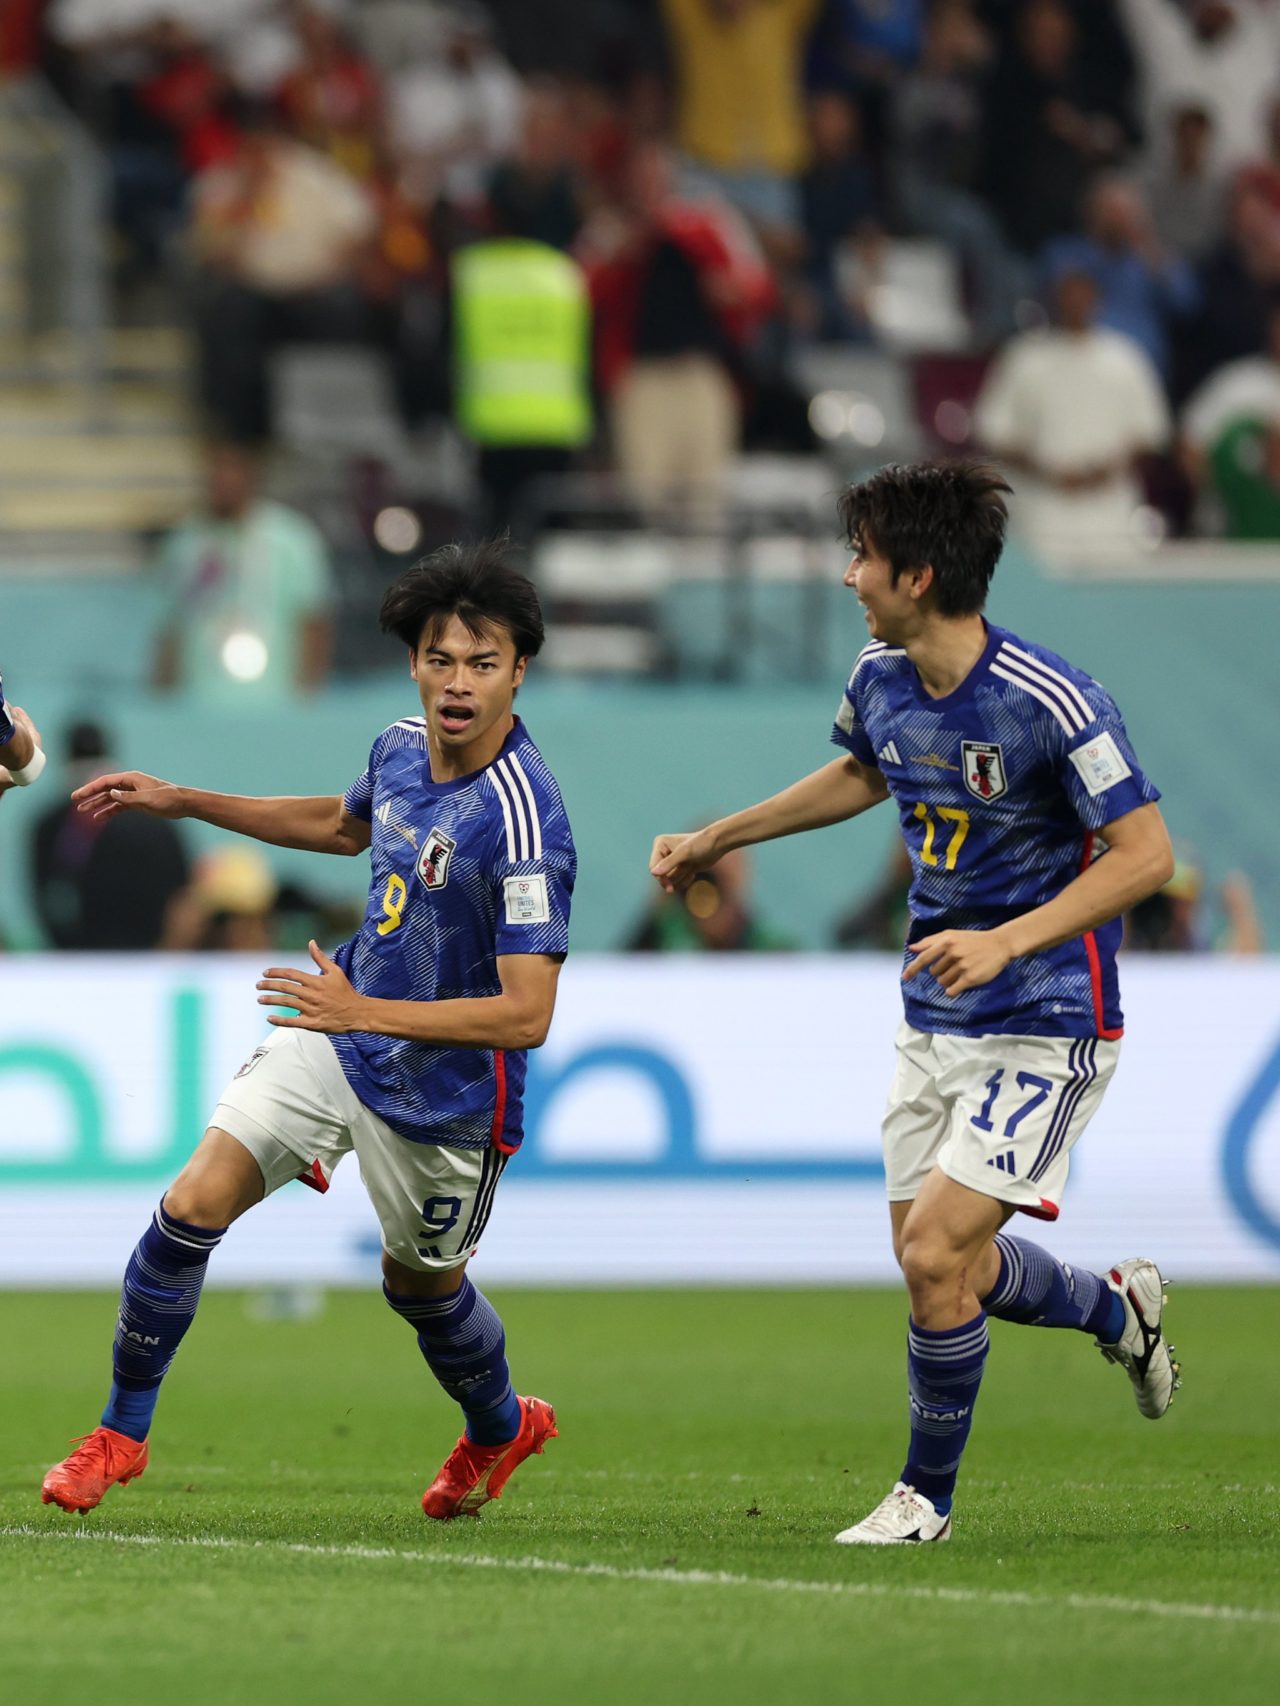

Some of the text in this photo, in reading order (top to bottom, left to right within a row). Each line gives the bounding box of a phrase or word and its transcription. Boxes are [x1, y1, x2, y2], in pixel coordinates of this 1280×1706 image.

[913, 801, 970, 870] 17
[376, 872, 407, 936] 9
[970, 1068, 1054, 1138] 17
[418, 1196, 462, 1239] 9
